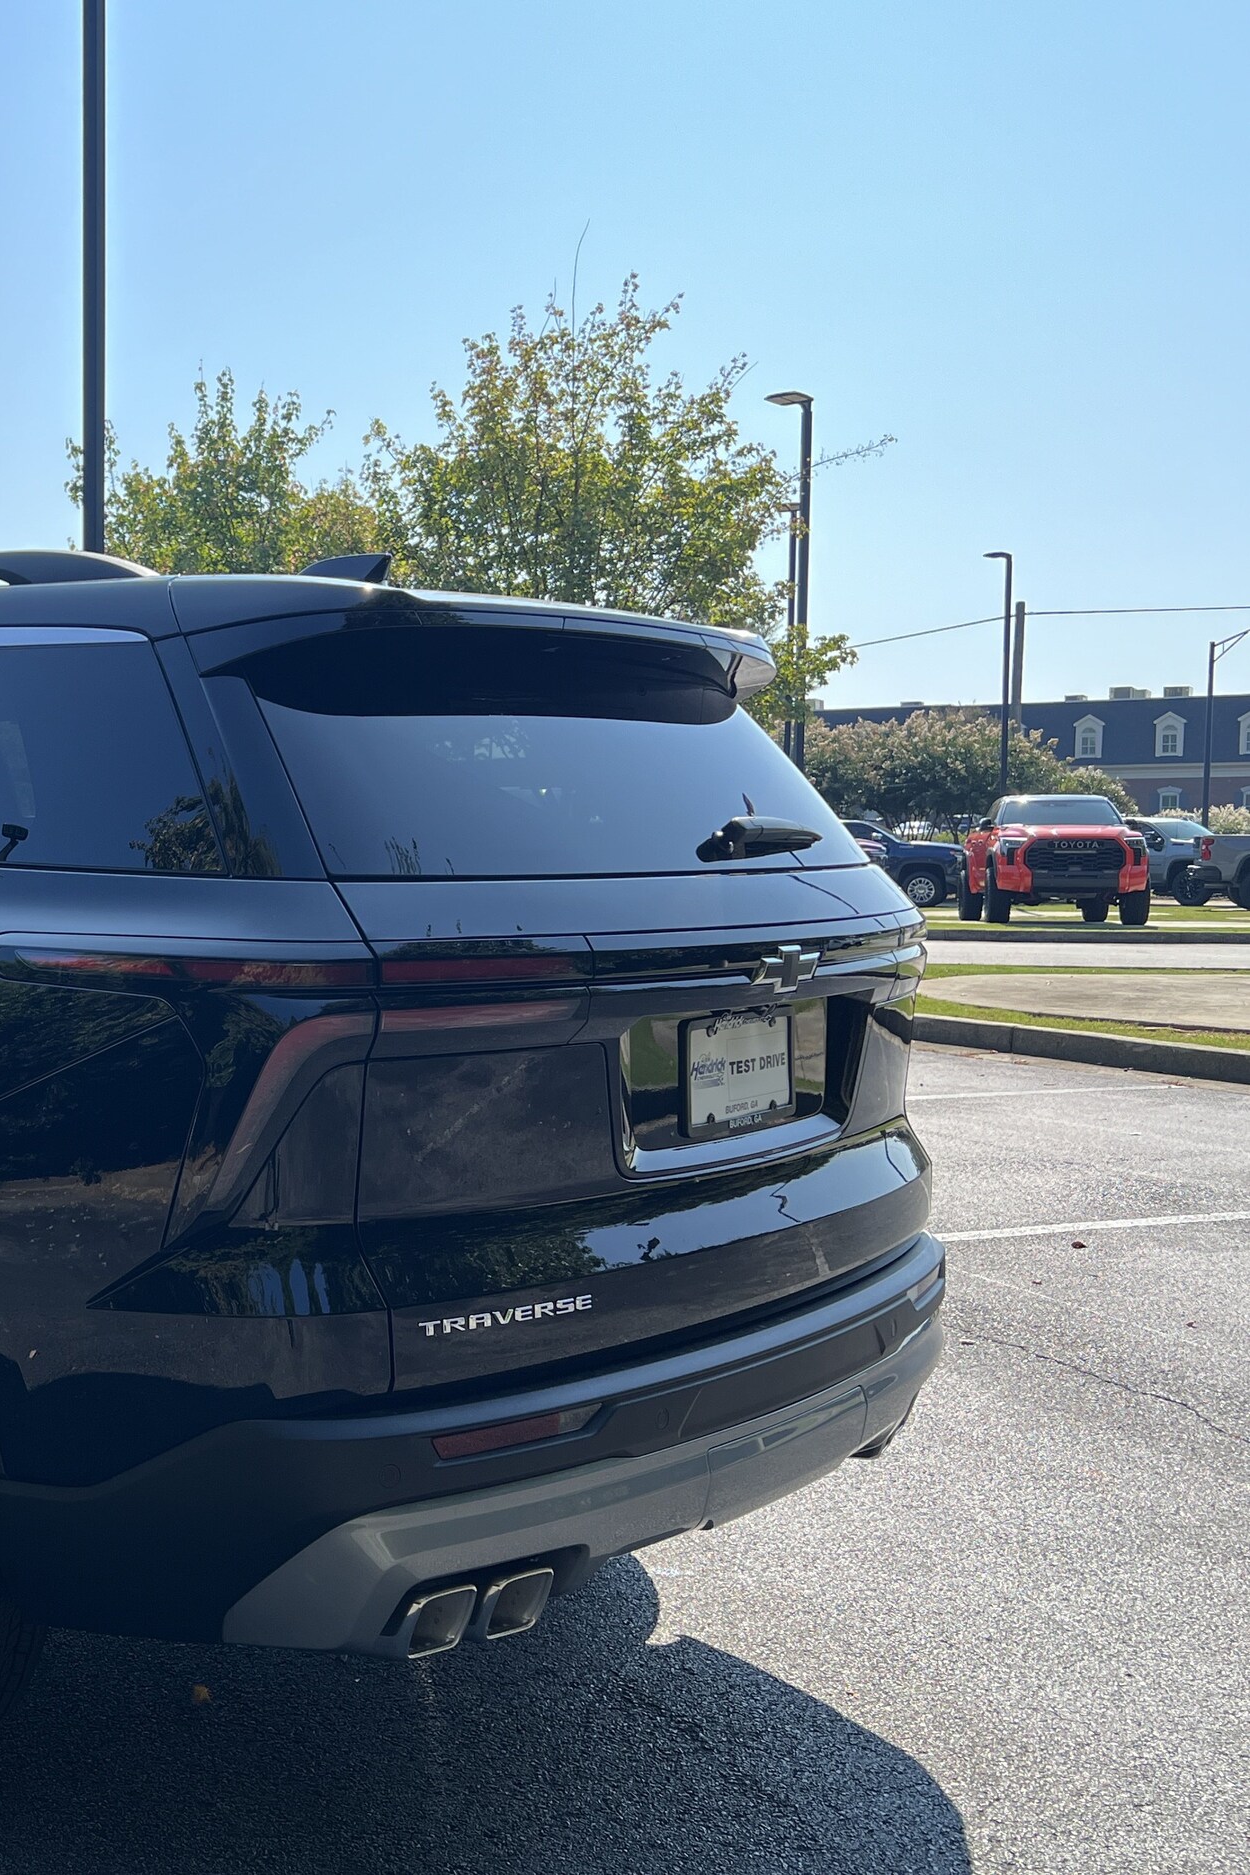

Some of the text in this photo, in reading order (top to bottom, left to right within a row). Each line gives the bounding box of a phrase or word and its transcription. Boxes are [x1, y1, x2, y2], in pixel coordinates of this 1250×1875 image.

[1053, 841, 1100, 849] TOYOTA
[729, 1052, 786, 1075] TEST DRIVE
[750, 1100, 759, 1108] GA
[753, 1114, 762, 1123] GA
[418, 1294, 592, 1336] TRAVERSE
